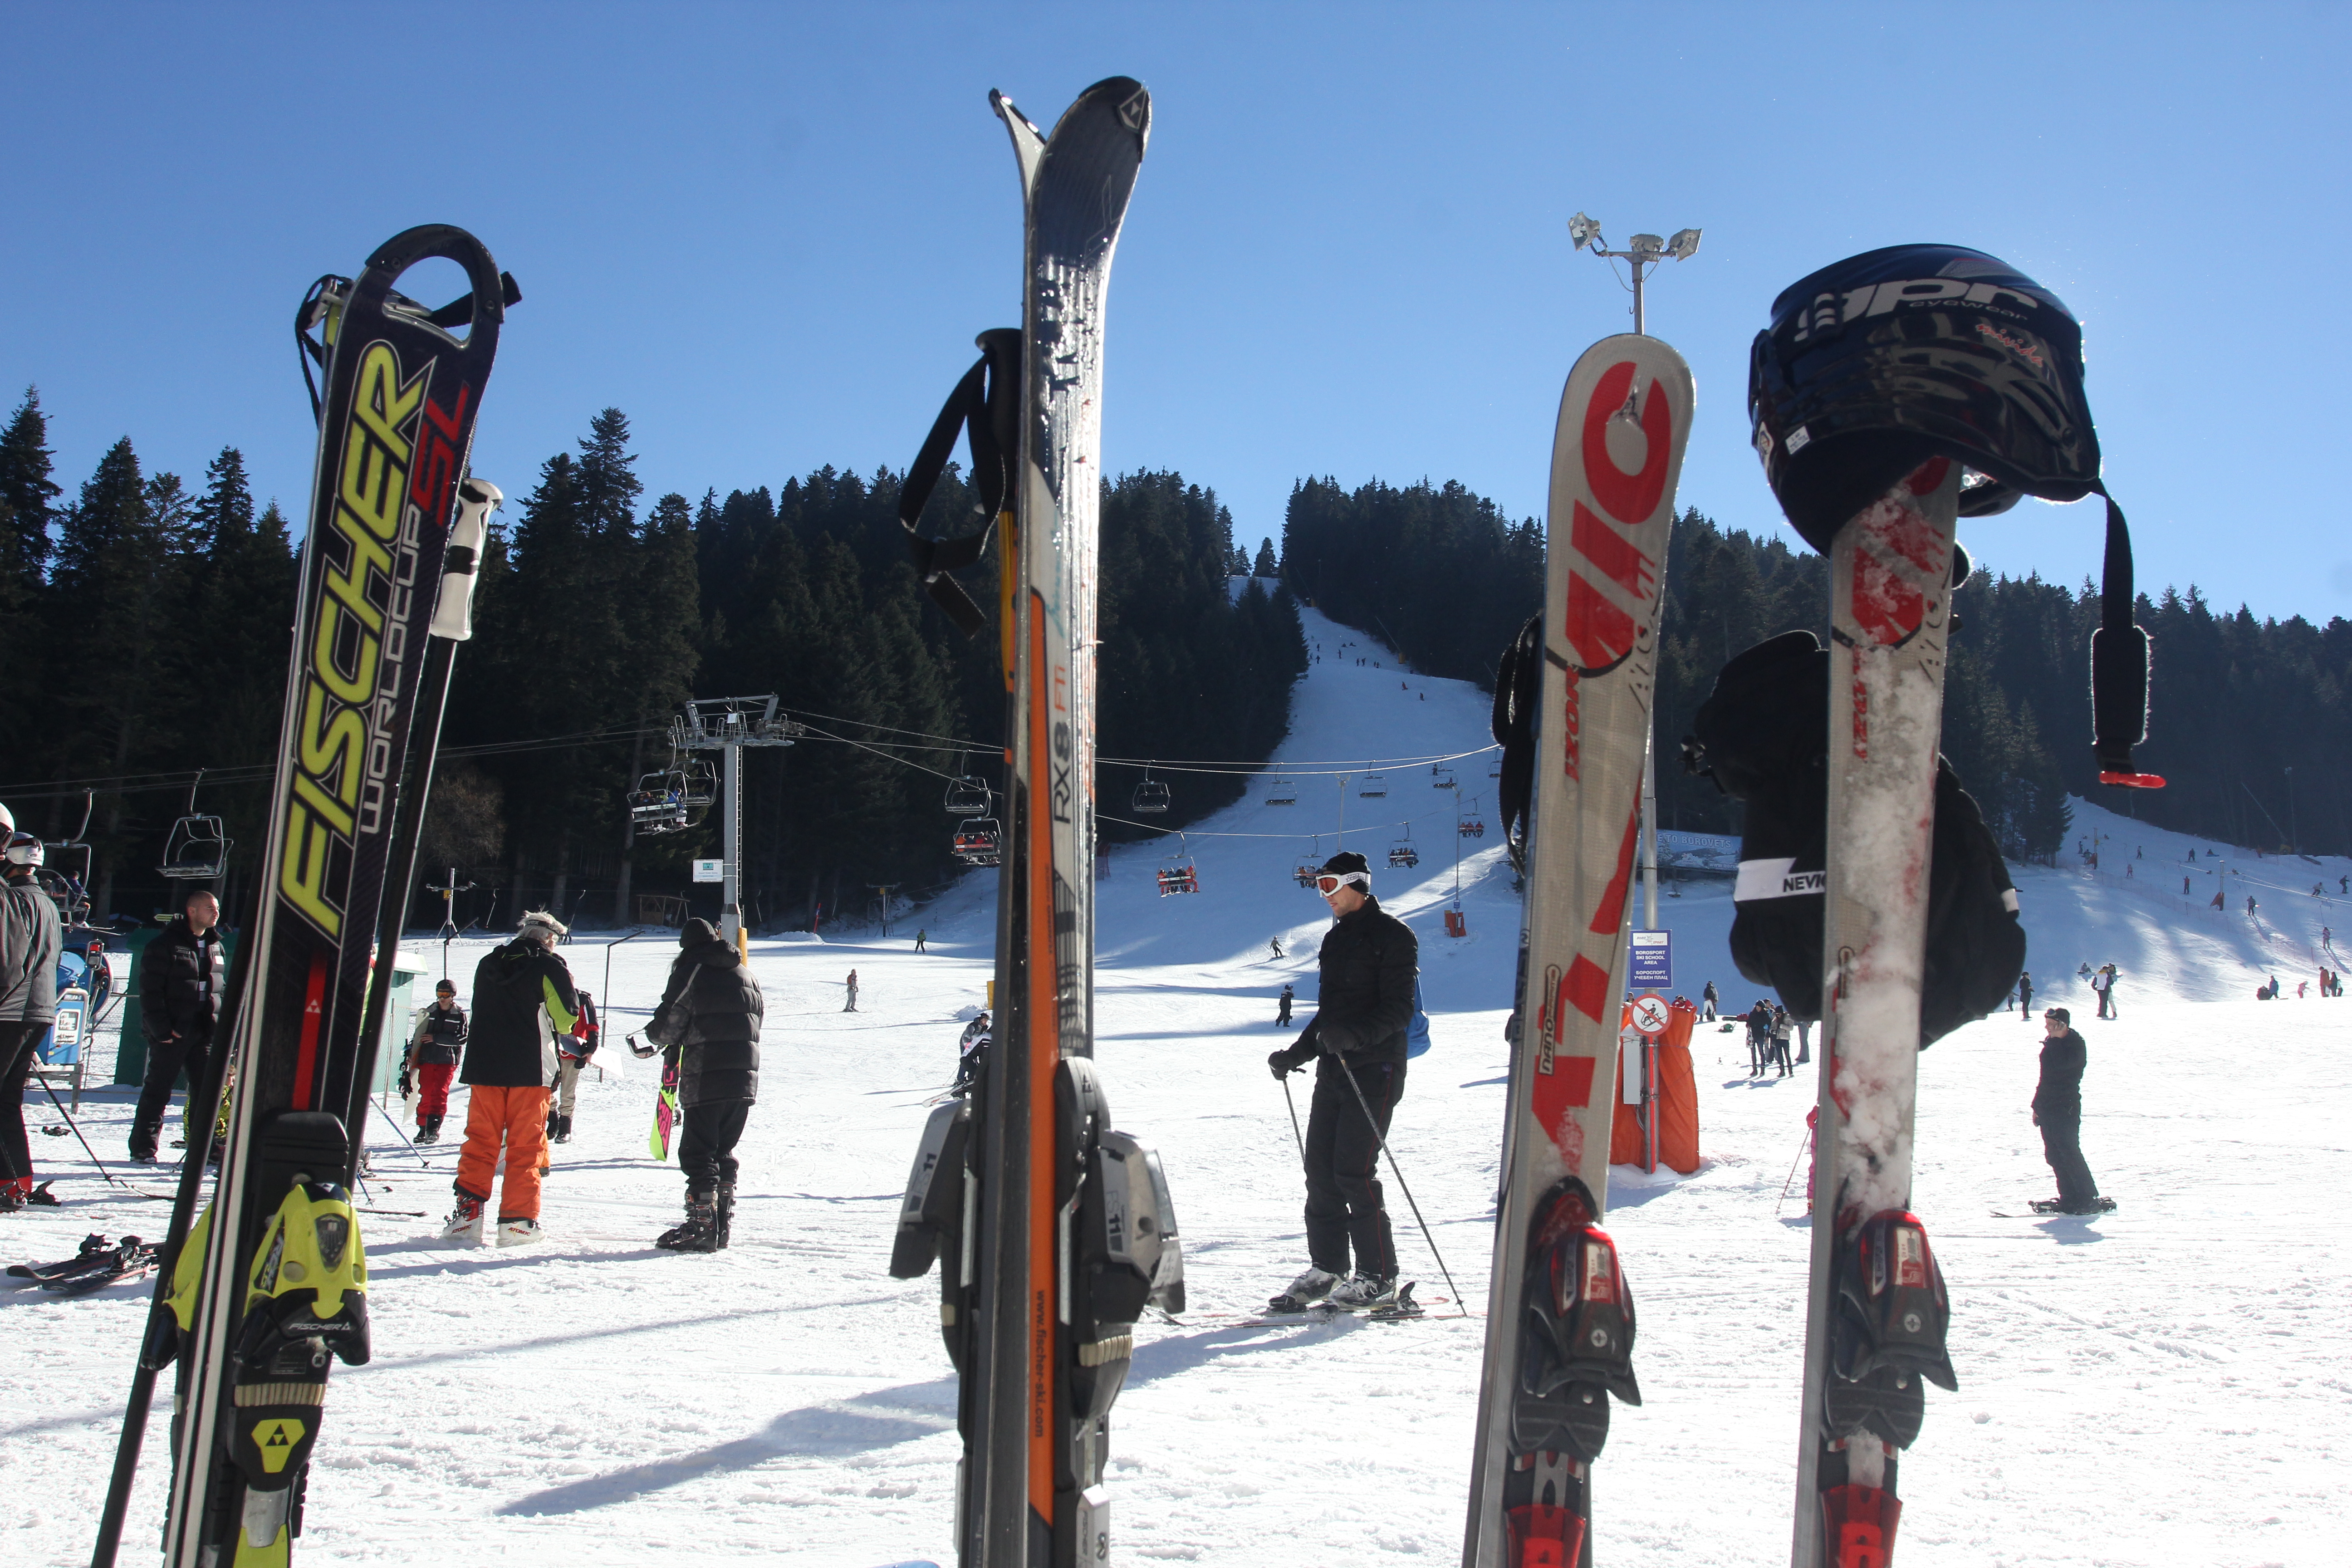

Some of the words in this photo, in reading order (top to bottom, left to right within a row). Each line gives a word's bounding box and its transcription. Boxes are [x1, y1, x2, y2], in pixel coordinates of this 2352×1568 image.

[411, 382, 470, 527] SL
[278, 339, 435, 939] FISCHER
[361, 504, 421, 834] WORLDCUP
[1054, 721, 1071, 824] RX8
[1565, 666, 1579, 783] IZOR
[1665, 834, 1678, 844] TO
[1681, 835, 1732, 848] BOROVETS
[451, 1225, 472, 1235] ATOMIC
[508, 1227, 531, 1236] ATOMIC
[1034, 1290, 1047, 1438] www.fischer-ski.com
